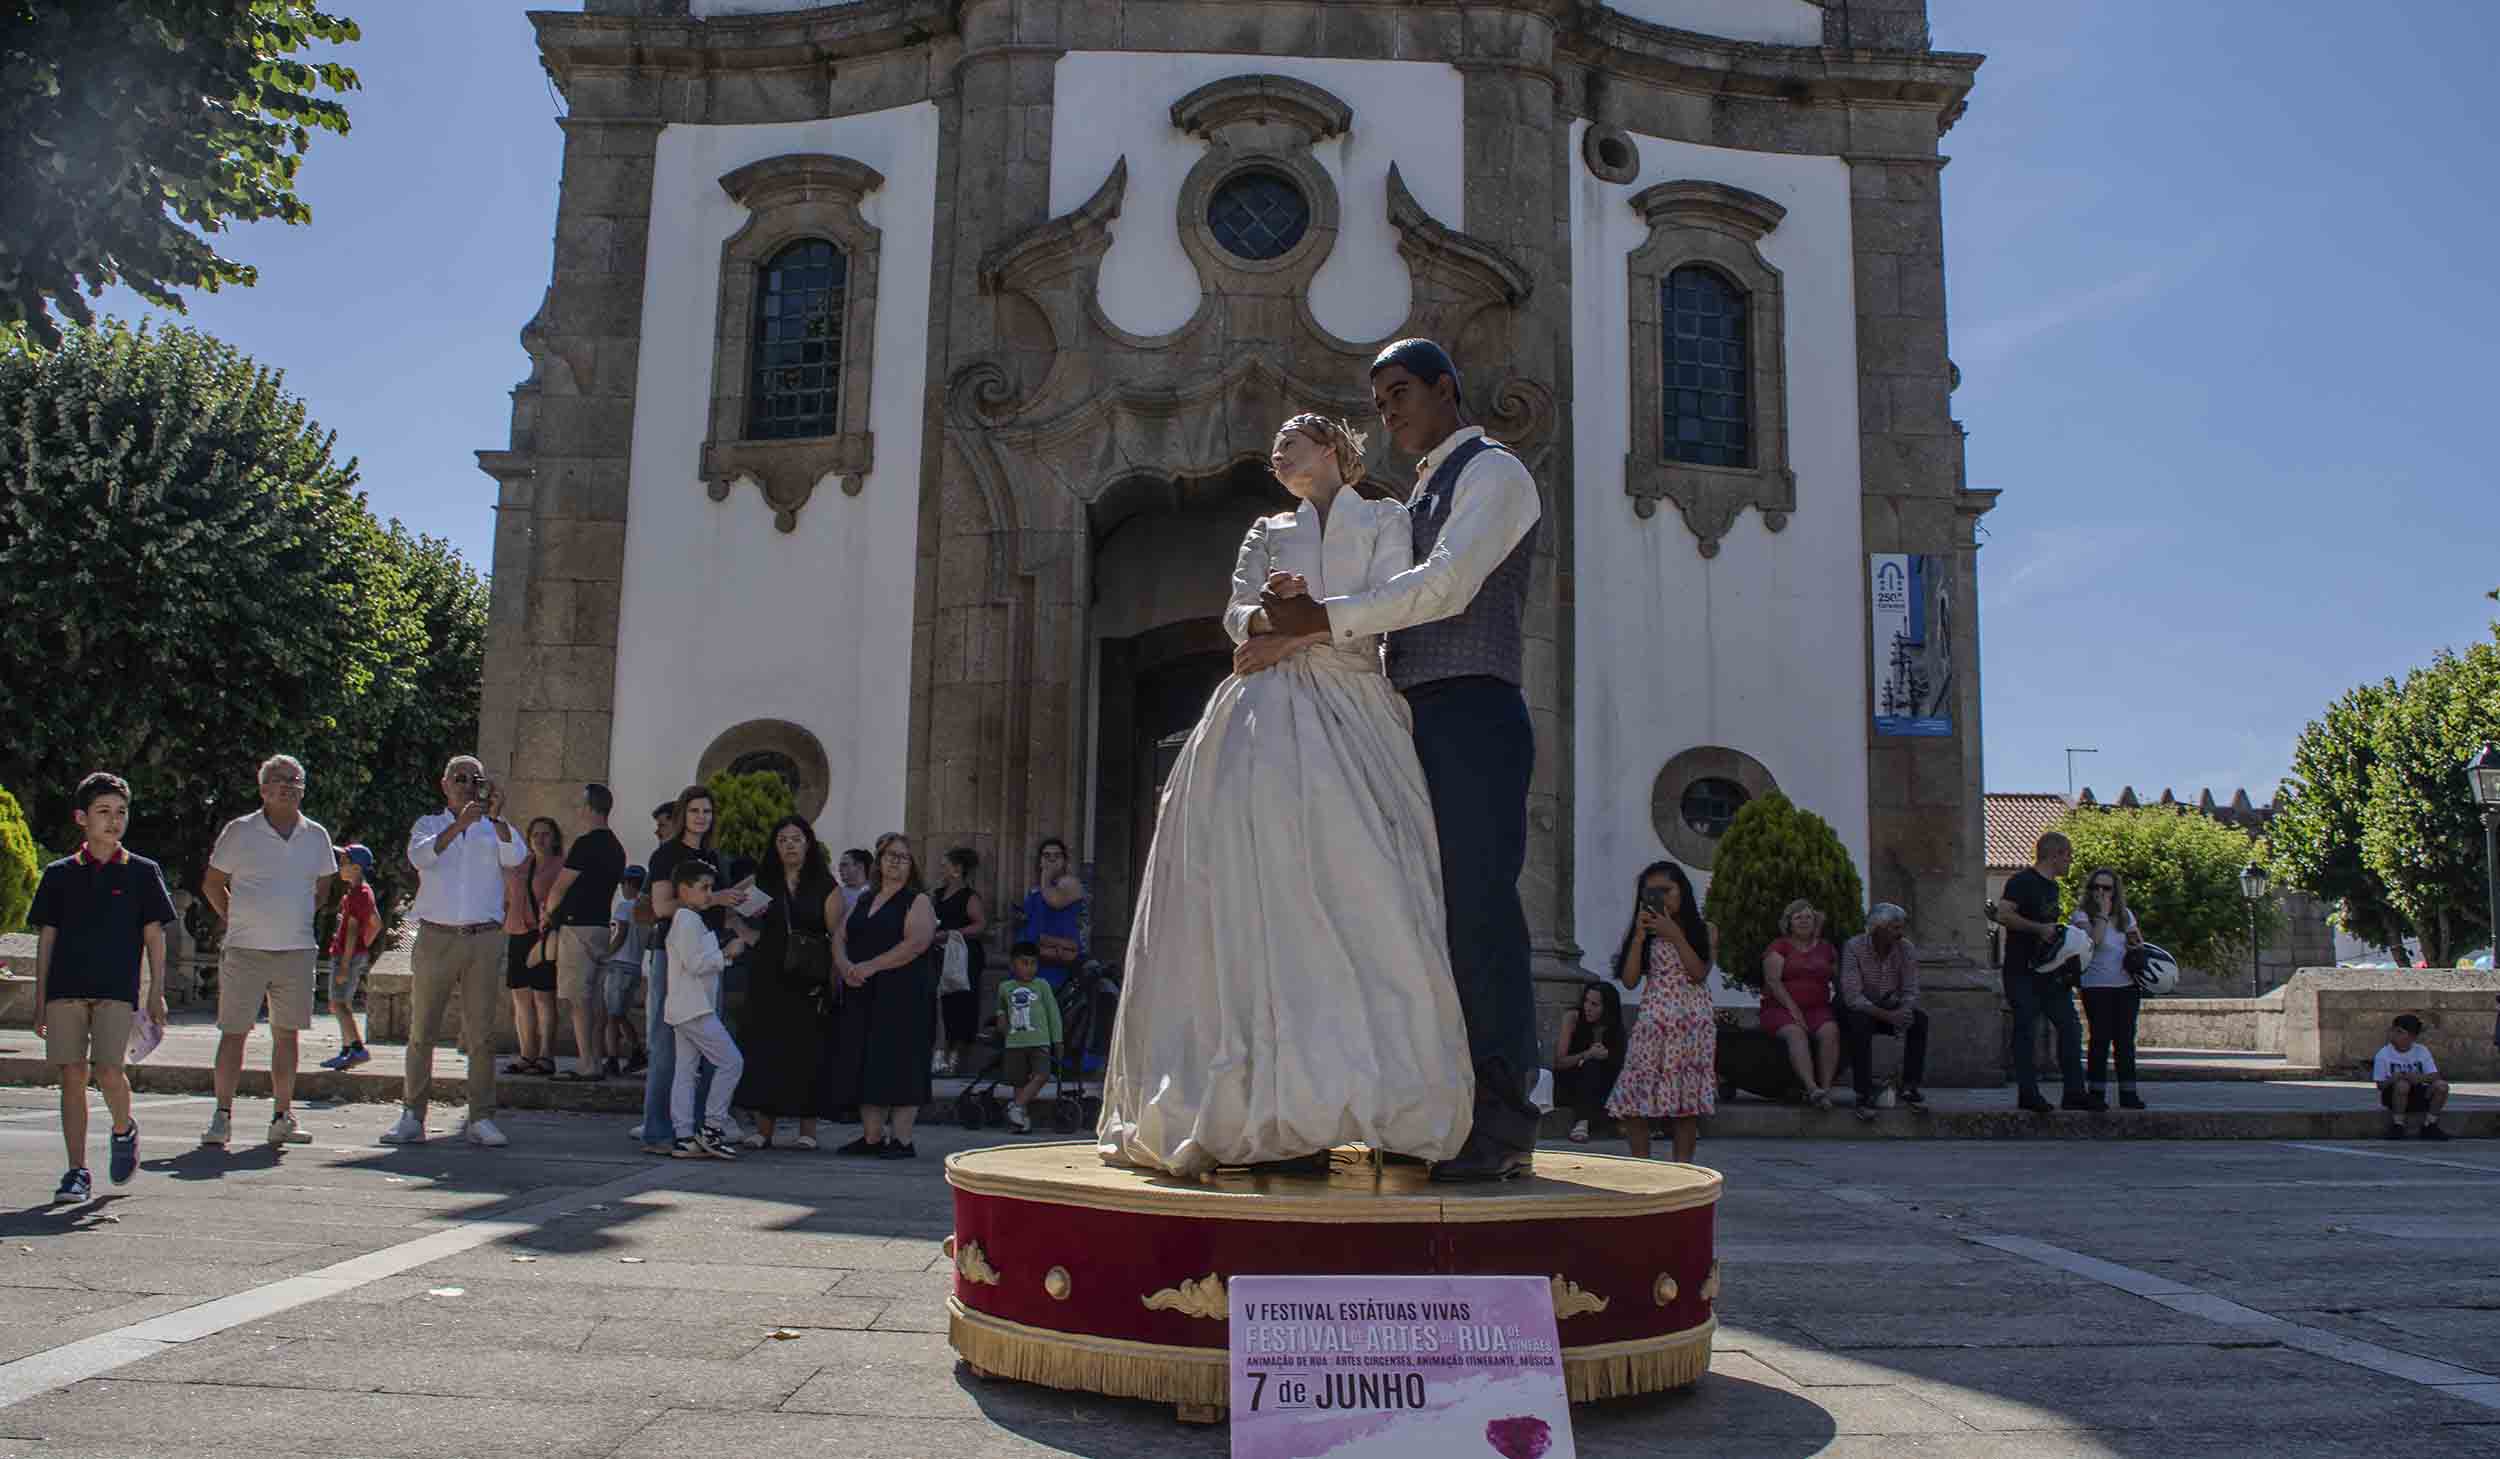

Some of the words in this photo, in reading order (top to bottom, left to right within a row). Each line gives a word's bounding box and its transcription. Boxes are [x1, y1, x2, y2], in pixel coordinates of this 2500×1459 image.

[1245, 1303, 1256, 1321] V
[1261, 1303, 1335, 1321] FESTIVAL
[1340, 1298, 1417, 1321] ESTÁTUAS
[1421, 1303, 1471, 1321] VIVAS
[1246, 1325, 1353, 1351] FESTIVAL
[1368, 1325, 1439, 1352] ARTES
[1459, 1325, 1507, 1352] RUA
[1335, 1355, 1362, 1367] ARTES
[1247, 1372, 1268, 1412] 7
[1278, 1379, 1307, 1403] de
[1315, 1372, 1426, 1410] JUNHO
